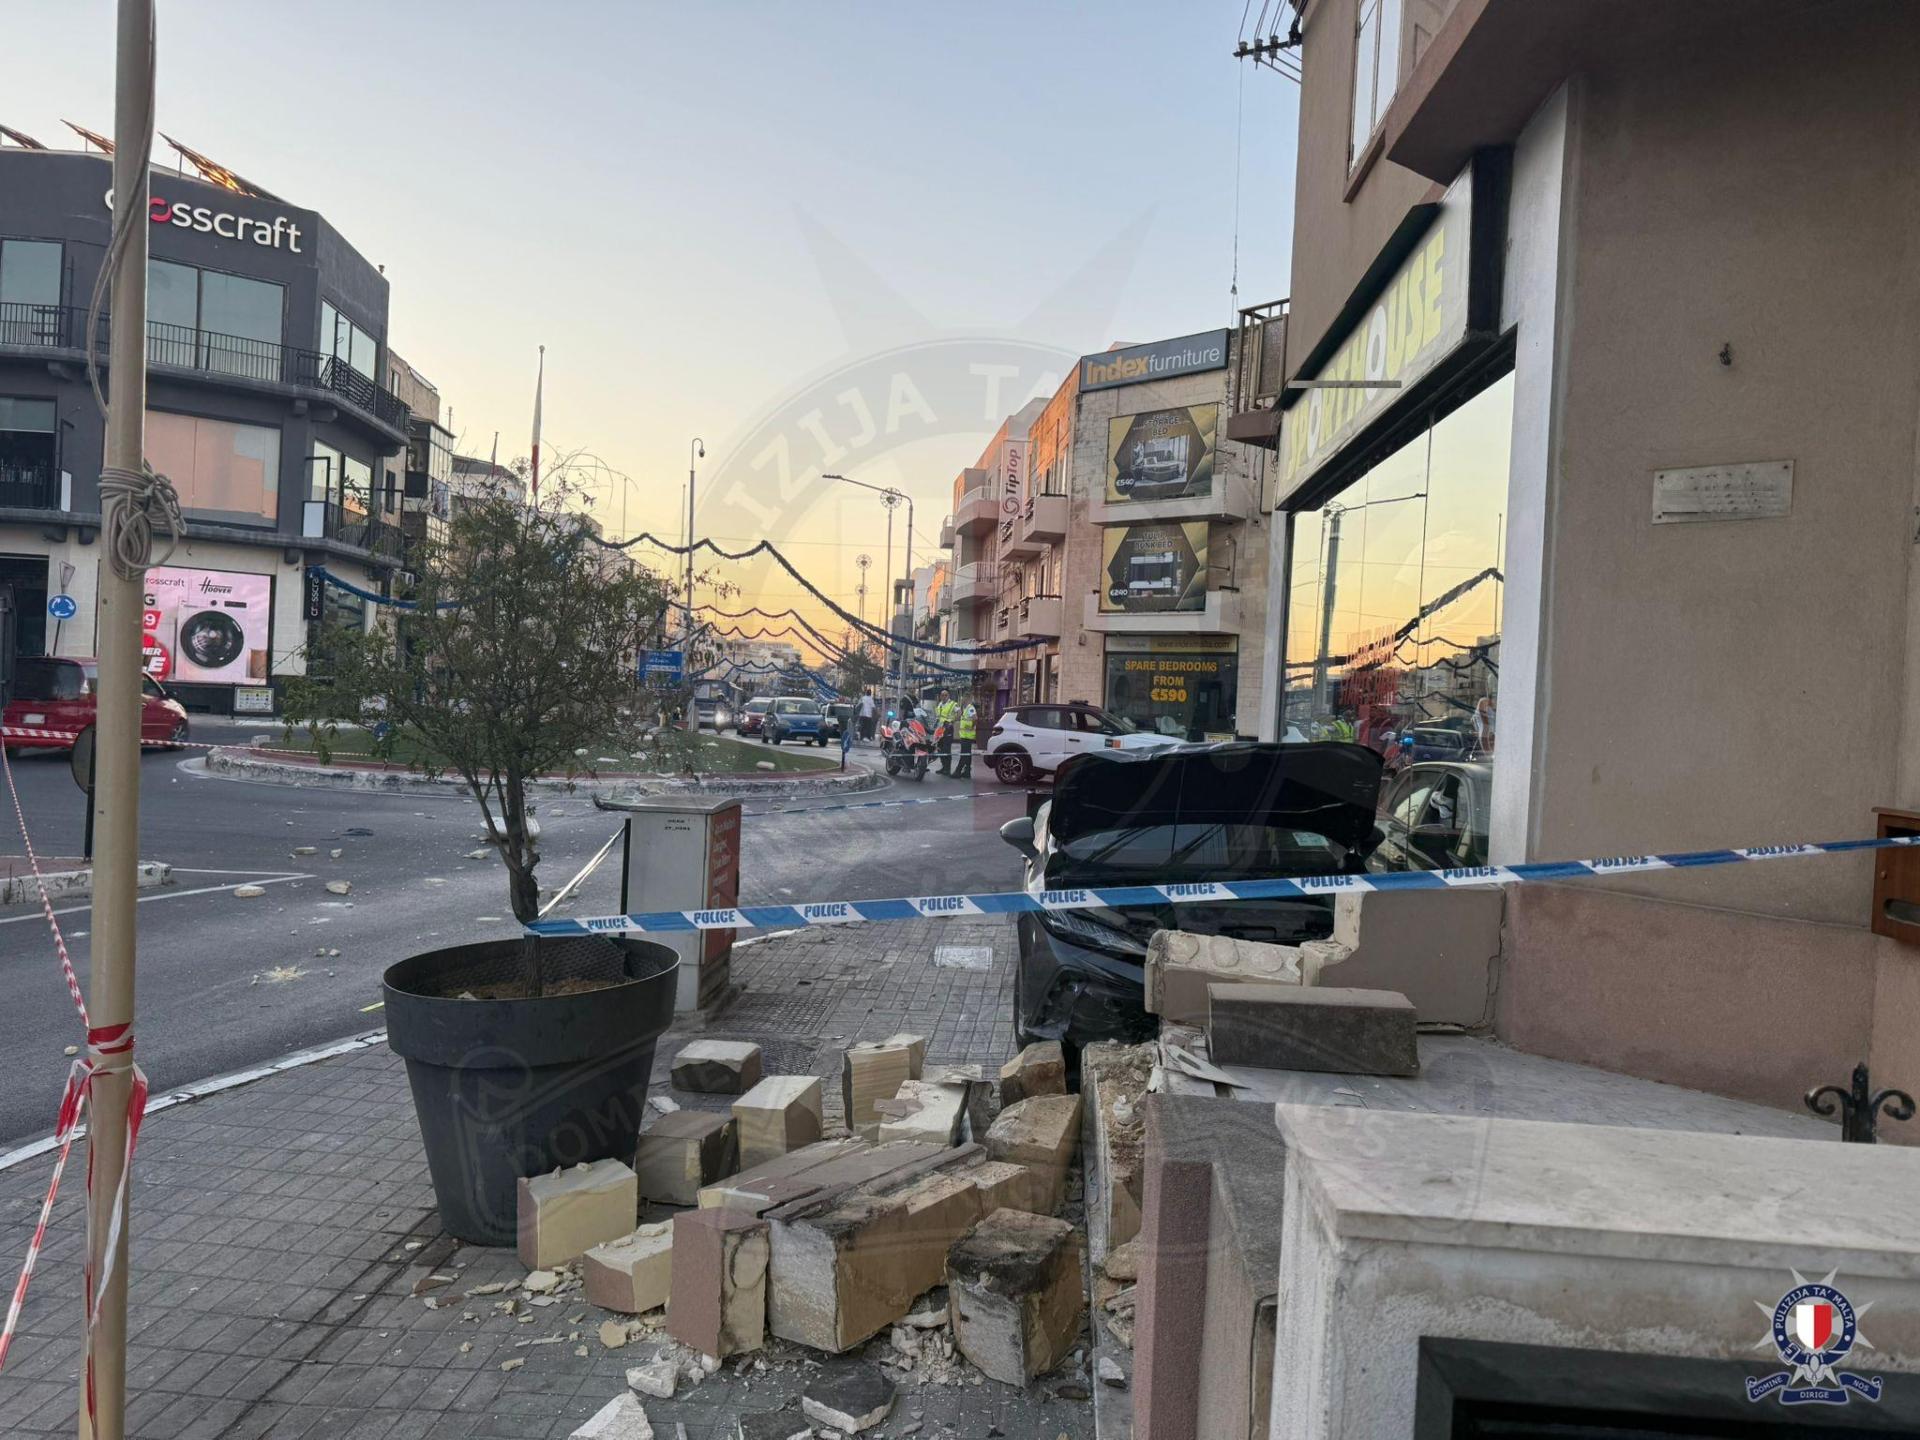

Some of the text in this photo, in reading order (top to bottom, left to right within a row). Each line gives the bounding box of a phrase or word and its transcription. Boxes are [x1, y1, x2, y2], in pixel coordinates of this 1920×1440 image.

[104, 188, 302, 254] cosscraft
[1006, 449, 1021, 495] TipTop
[145, 577, 185, 588] rosscraft
[1125, 661, 1217, 672] SPARE BEDROOMS
[1153, 675, 1185, 686] FROM
[1151, 688, 1188, 702] €590
[587, 917, 629, 930] POLICE
[693, 911, 736, 924] POLICE
[804, 904, 847, 918] POLICE
[919, 896, 964, 911] POLICE
[1039, 890, 1087, 904] POLICE
[1166, 883, 1216, 897] POLICE
[1300, 875, 1353, 888] POLICE
[1443, 866, 1498, 879] POLICE
